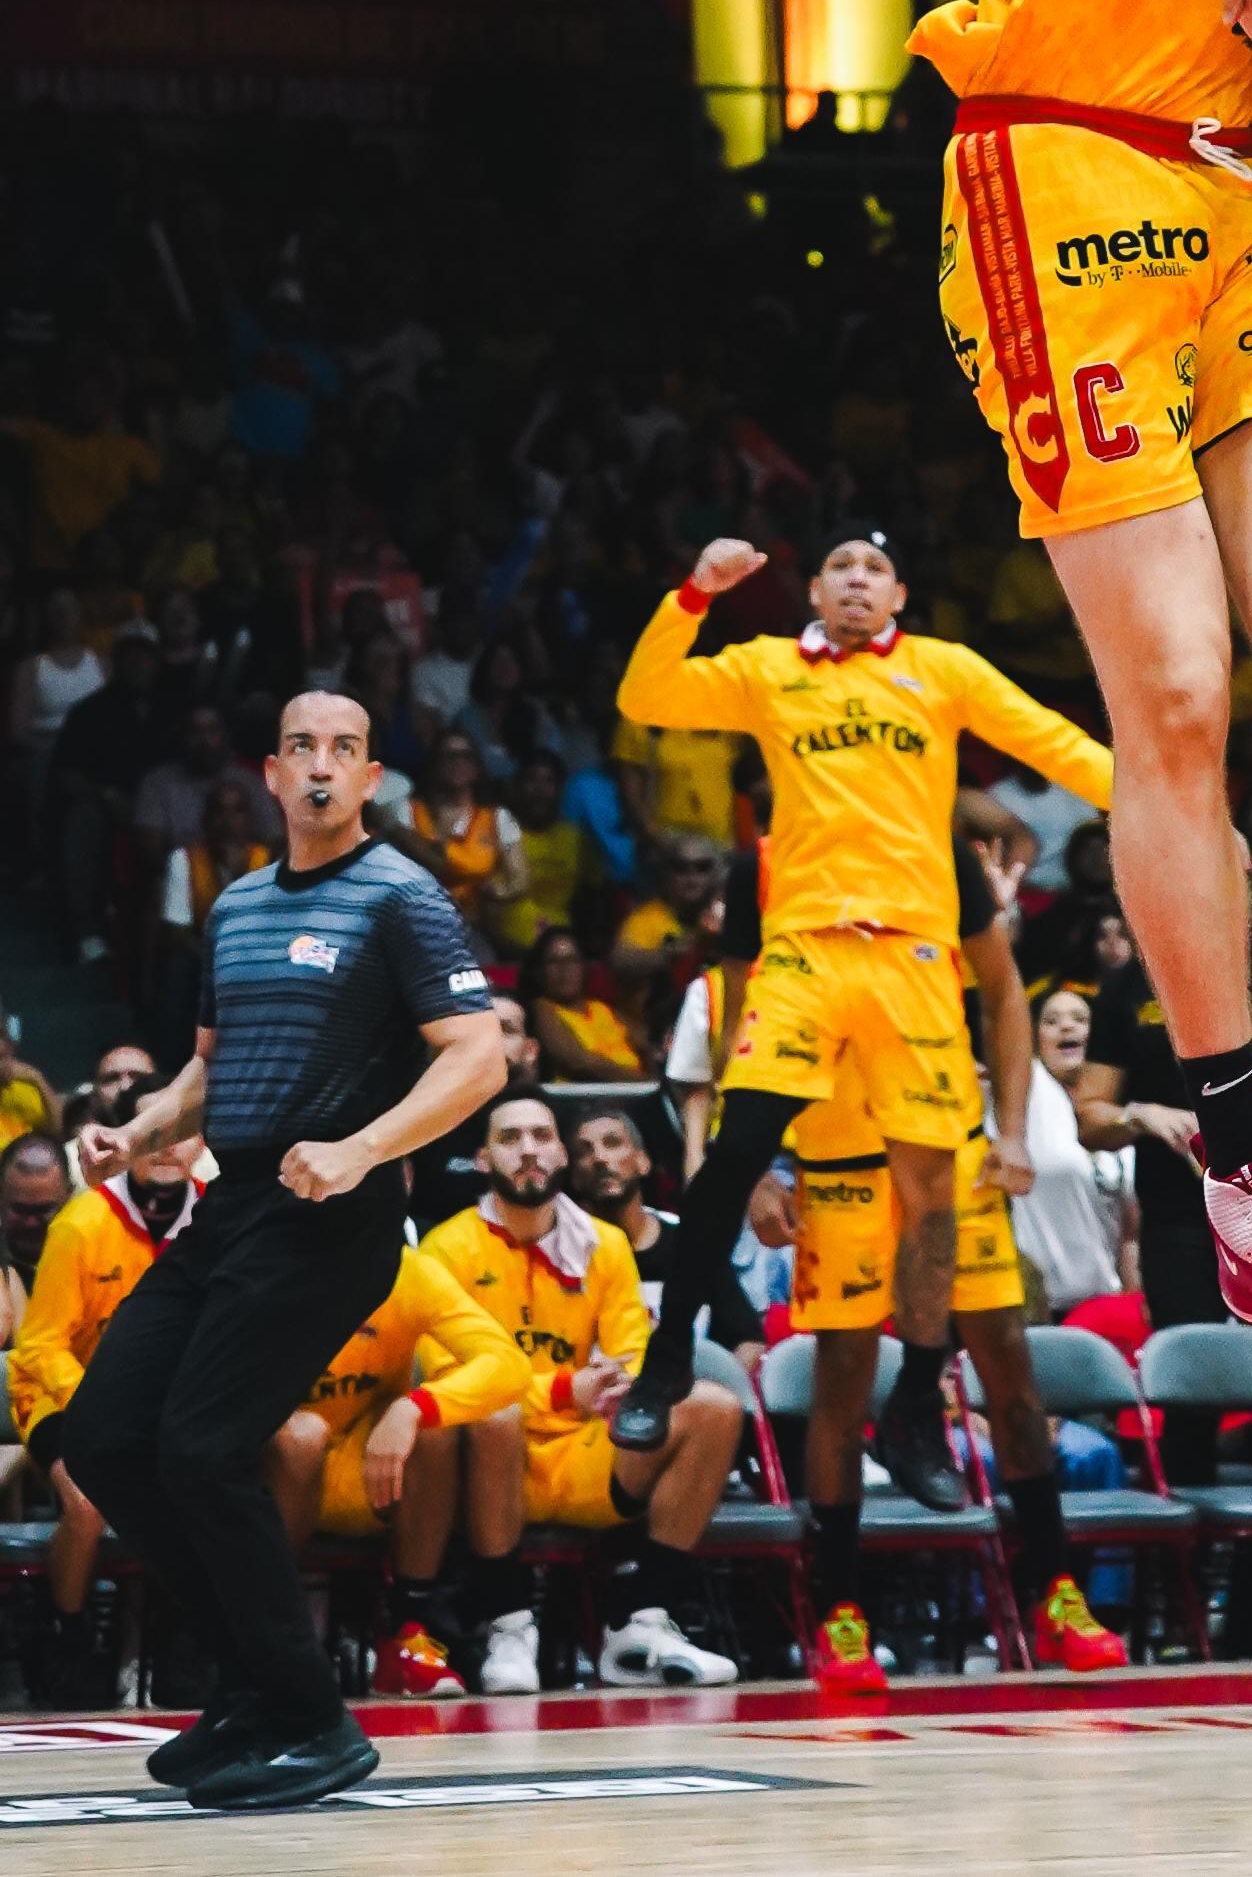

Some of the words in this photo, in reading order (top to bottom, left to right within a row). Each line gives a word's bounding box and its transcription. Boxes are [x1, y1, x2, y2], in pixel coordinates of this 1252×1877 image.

[1056, 221, 1209, 270] metro
[1088, 271, 1106, 288] by
[1072, 362, 1141, 463] C
